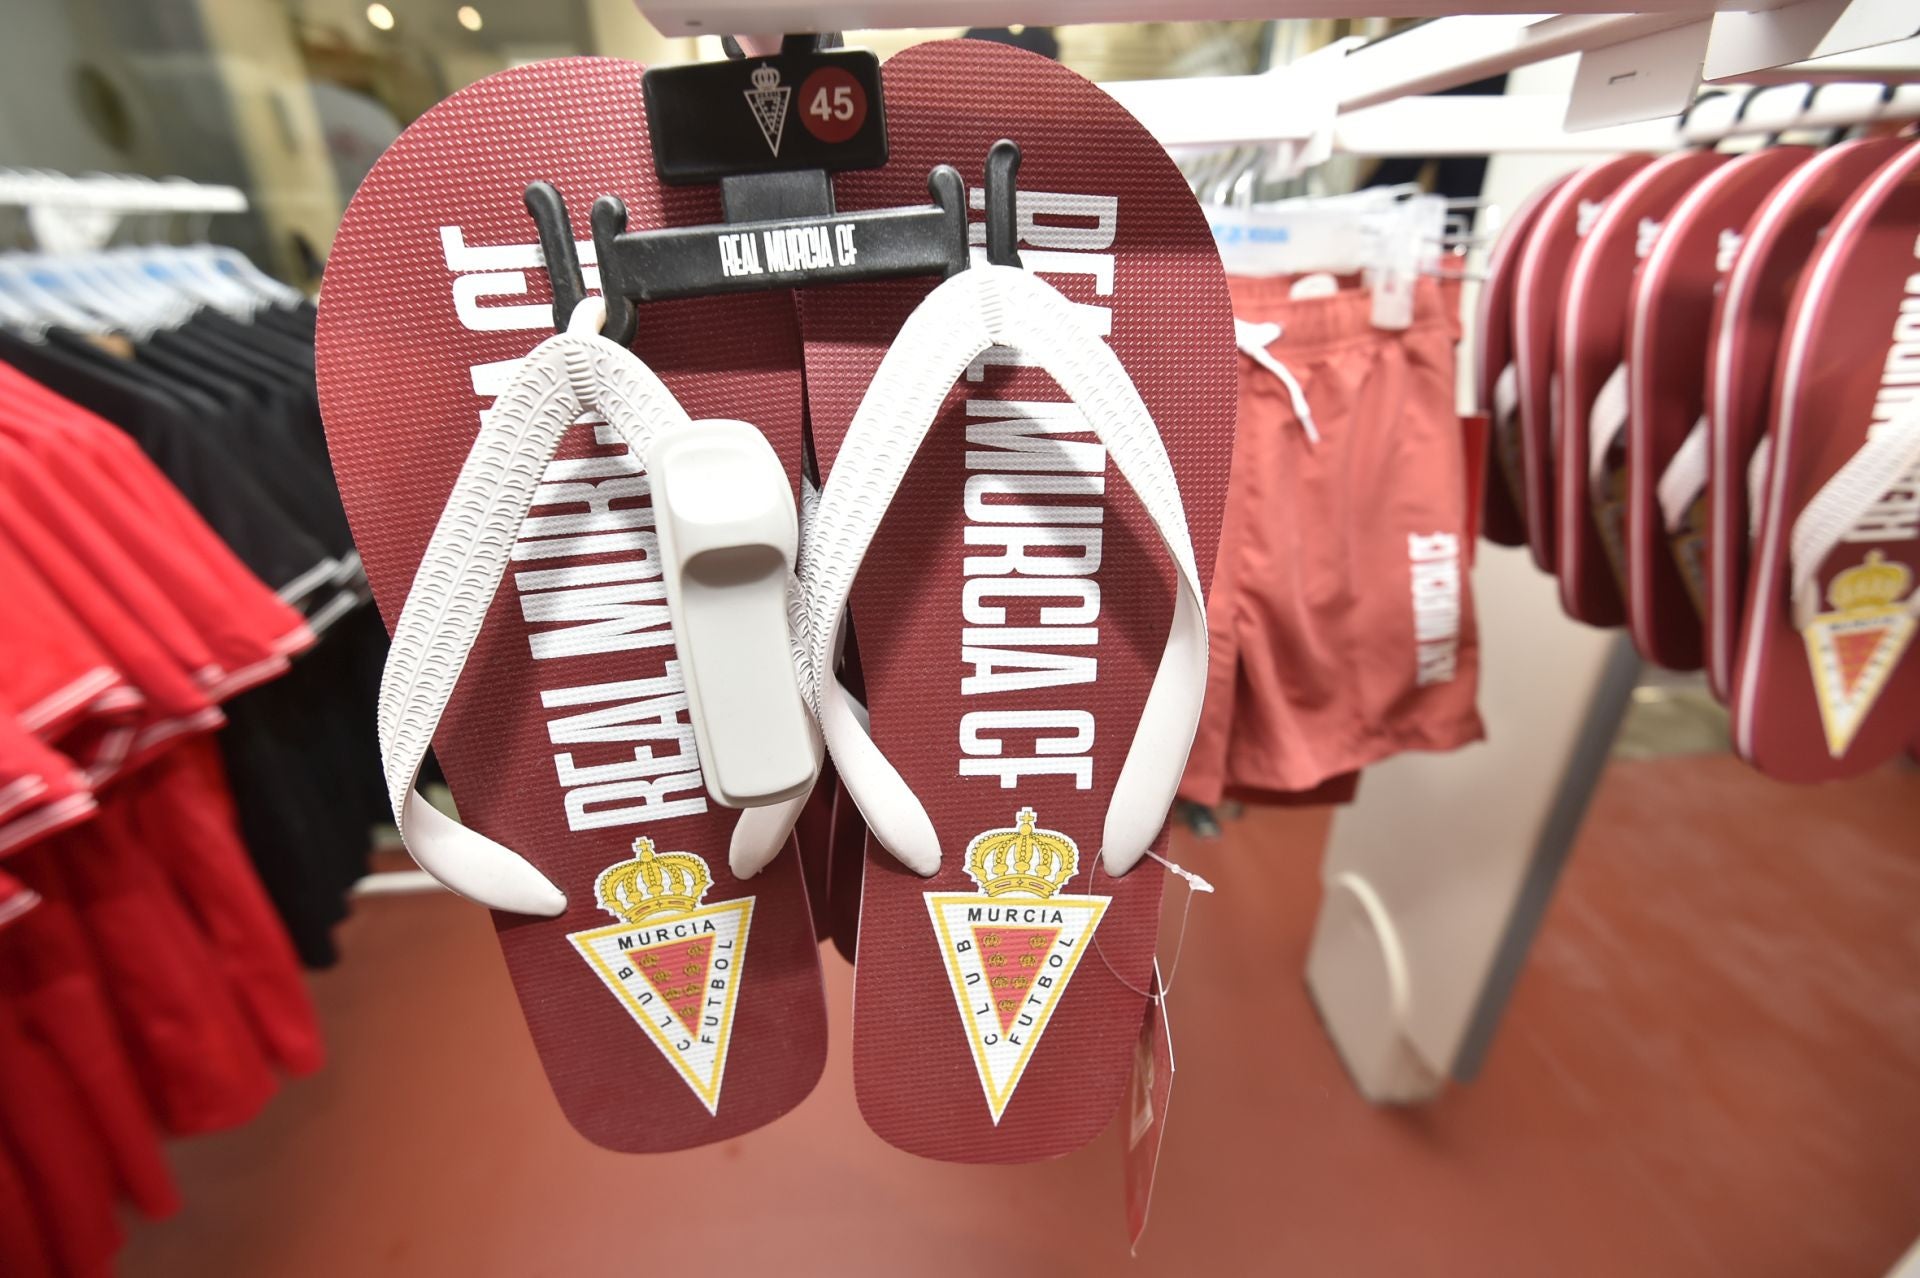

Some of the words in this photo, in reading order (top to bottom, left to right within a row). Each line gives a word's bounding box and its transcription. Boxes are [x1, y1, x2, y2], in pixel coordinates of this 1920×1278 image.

[809, 86, 854, 121] 45
[718, 232, 763, 277] REAL
[763, 225, 835, 273] MURCIA
[835, 223, 858, 267] CF
[961, 399, 1107, 696] MURCIA
[541, 659, 708, 831] REAL
[958, 709, 1096, 790] CF
[617, 918, 716, 951] MURCIA
[967, 907, 1064, 924] MURCIA
[618, 965, 691, 1052] CLUB
[701, 939, 733, 1044] FUTBOL
[956, 938, 998, 1046] CLUB
[1008, 936, 1074, 1046] FUTBOL
